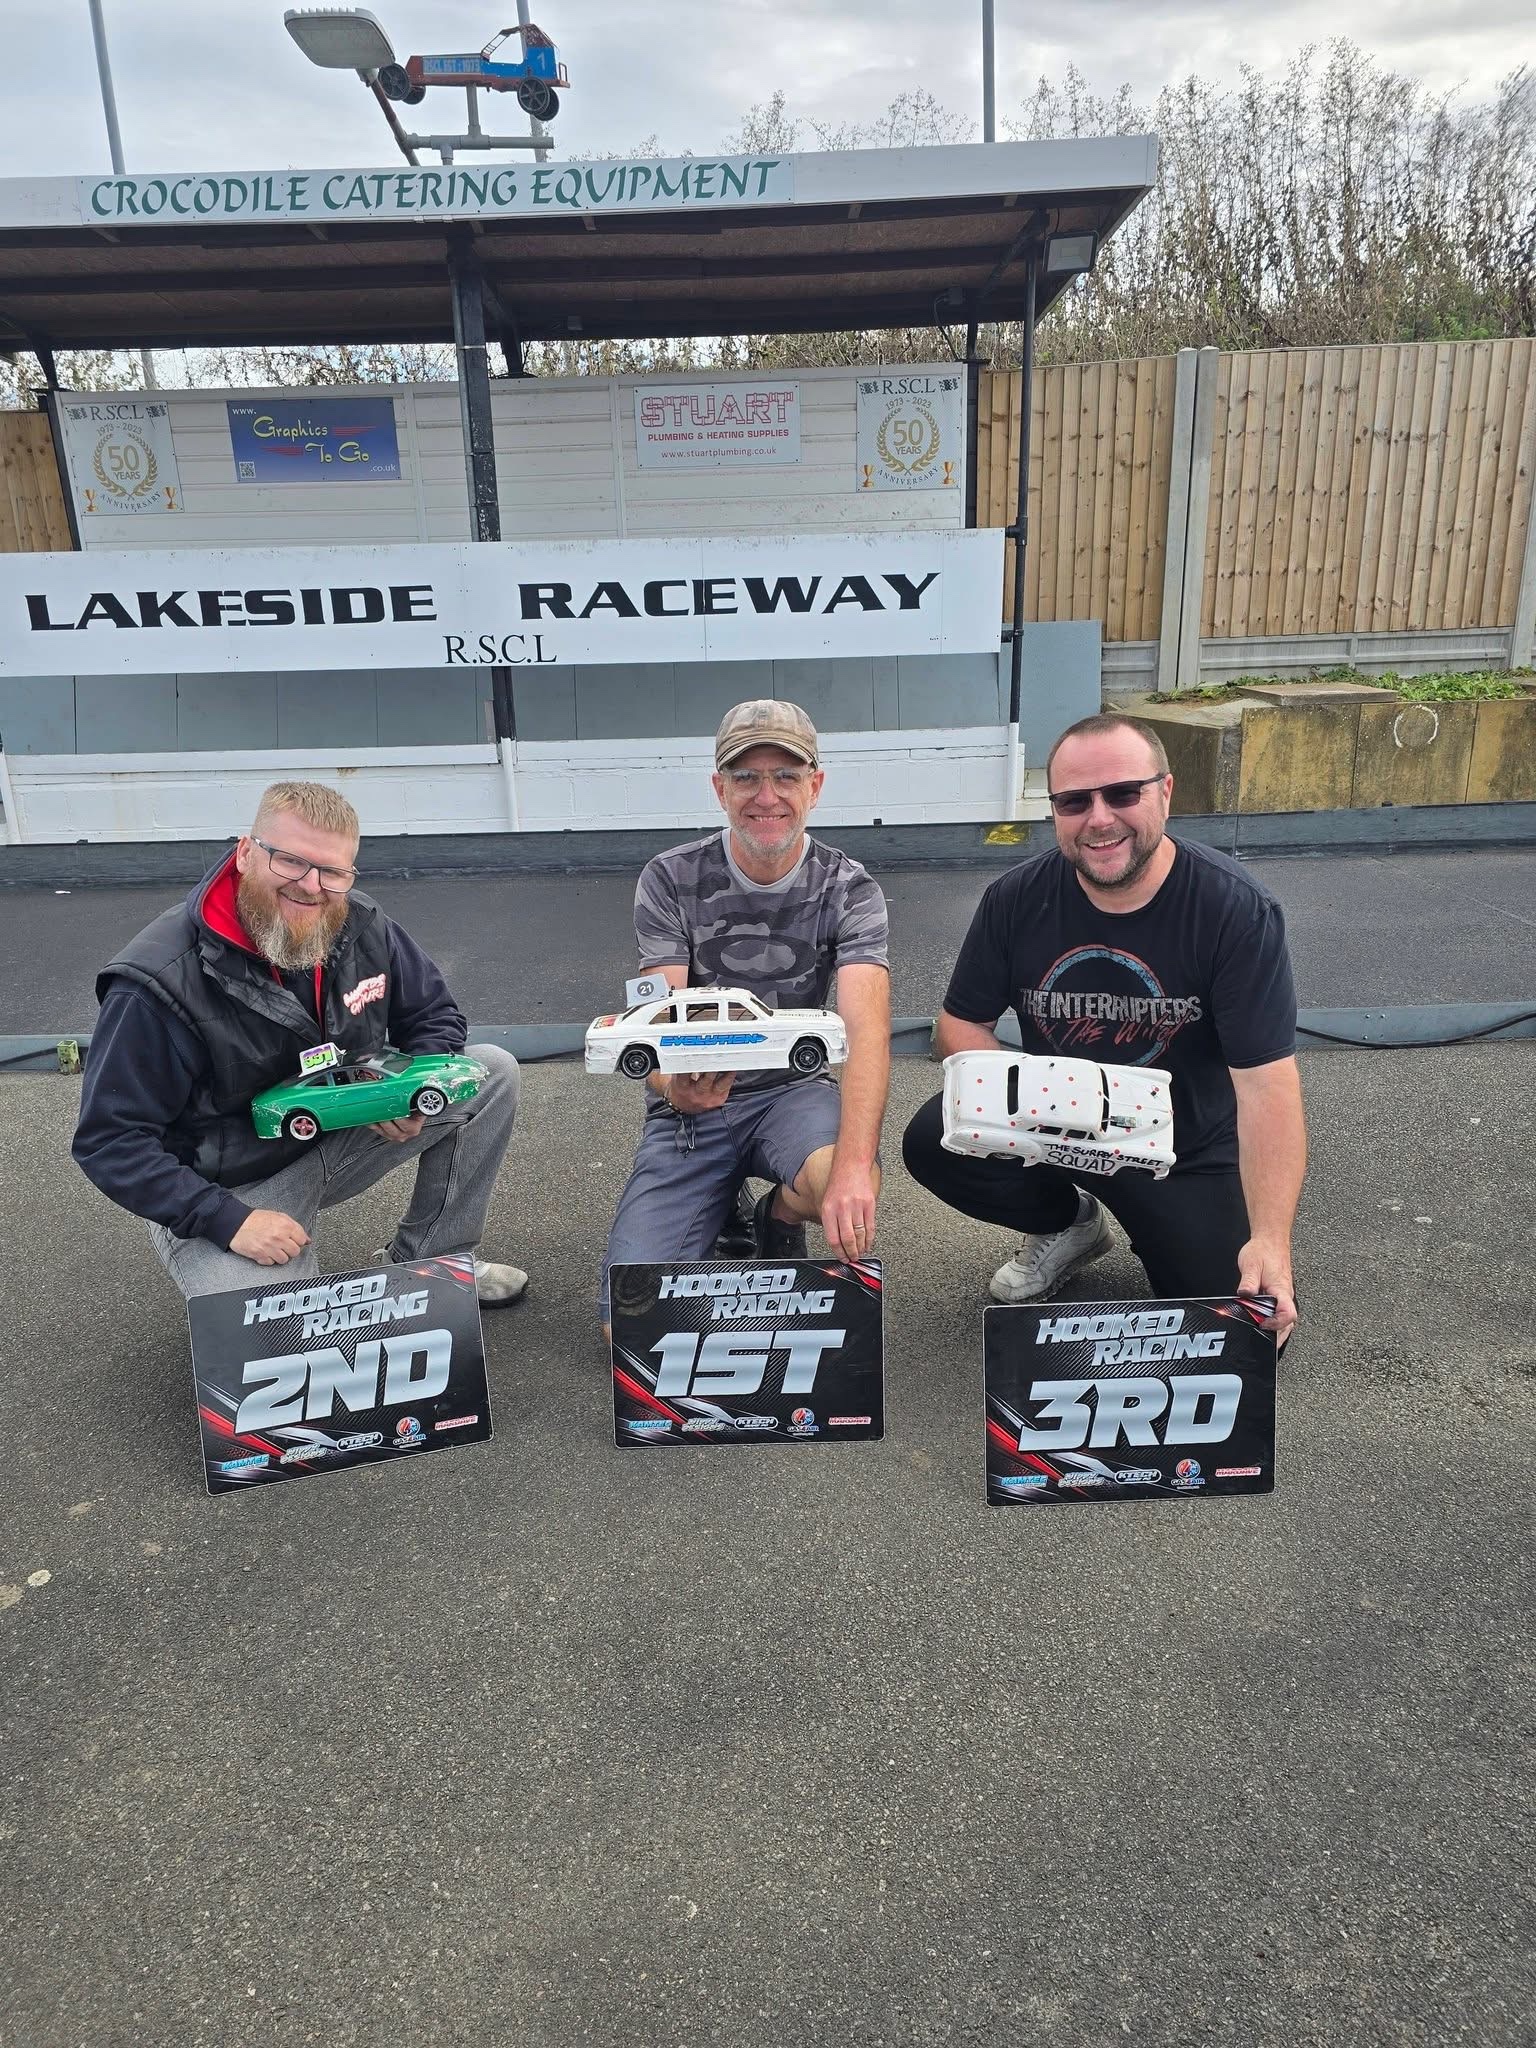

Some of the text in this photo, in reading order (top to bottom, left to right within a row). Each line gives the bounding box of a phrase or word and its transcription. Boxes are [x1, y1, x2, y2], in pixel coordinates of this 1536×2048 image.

[92, 160, 781, 216] CROCODILE CATERING EQUIPMENT
[882, 378, 936, 395] R.S.C.L
[90, 404, 145, 421] R.S.C.L
[640, 391, 794, 428] STUART
[912, 397, 932, 409] 2023
[122, 422, 143, 435] 2023
[253, 415, 328, 442] Graphics
[647, 429, 789, 442] PLUMBING & HEATING SUPPLIES
[893, 419, 924, 446] 50
[107, 445, 140, 471] 50
[304, 441, 370, 463] To Go
[661, 446, 777, 459] www.stuartplumbing.co.uk
[895, 446, 922, 455] YEARS
[113, 471, 141, 481] YEARS
[370, 463, 396, 473] .co.uk
[878, 465, 939, 486] ANNIVERSARY
[101, 491, 162, 510] ANNIVERSARY
[24, 572, 941, 631] LAKESIDE RACEWAY
[442, 634, 557, 664] R.S.C.L
[640, 983, 652, 995] 21
[1021, 988, 1202, 1027] THE INTERRUPTERS
[660, 1033, 768, 1047] EVOLUTION
[1044, 1143, 1070, 1152] THE
[1116, 1154, 1163, 1167] STREET
[1045, 1150, 1116, 1172] SQUAD
[658, 1268, 797, 1300] HOOKED
[243, 1273, 388, 1325] HOOKED
[710, 1289, 836, 1321] RACING
[300, 1289, 430, 1340] RACING
[1035, 1308, 1185, 1345] HOOKED
[1091, 1330, 1227, 1367] RACING
[649, 1329, 846, 1397] 1ST
[234, 1328, 453, 1434] 2ND
[1018, 1373, 1243, 1452] 3RD
